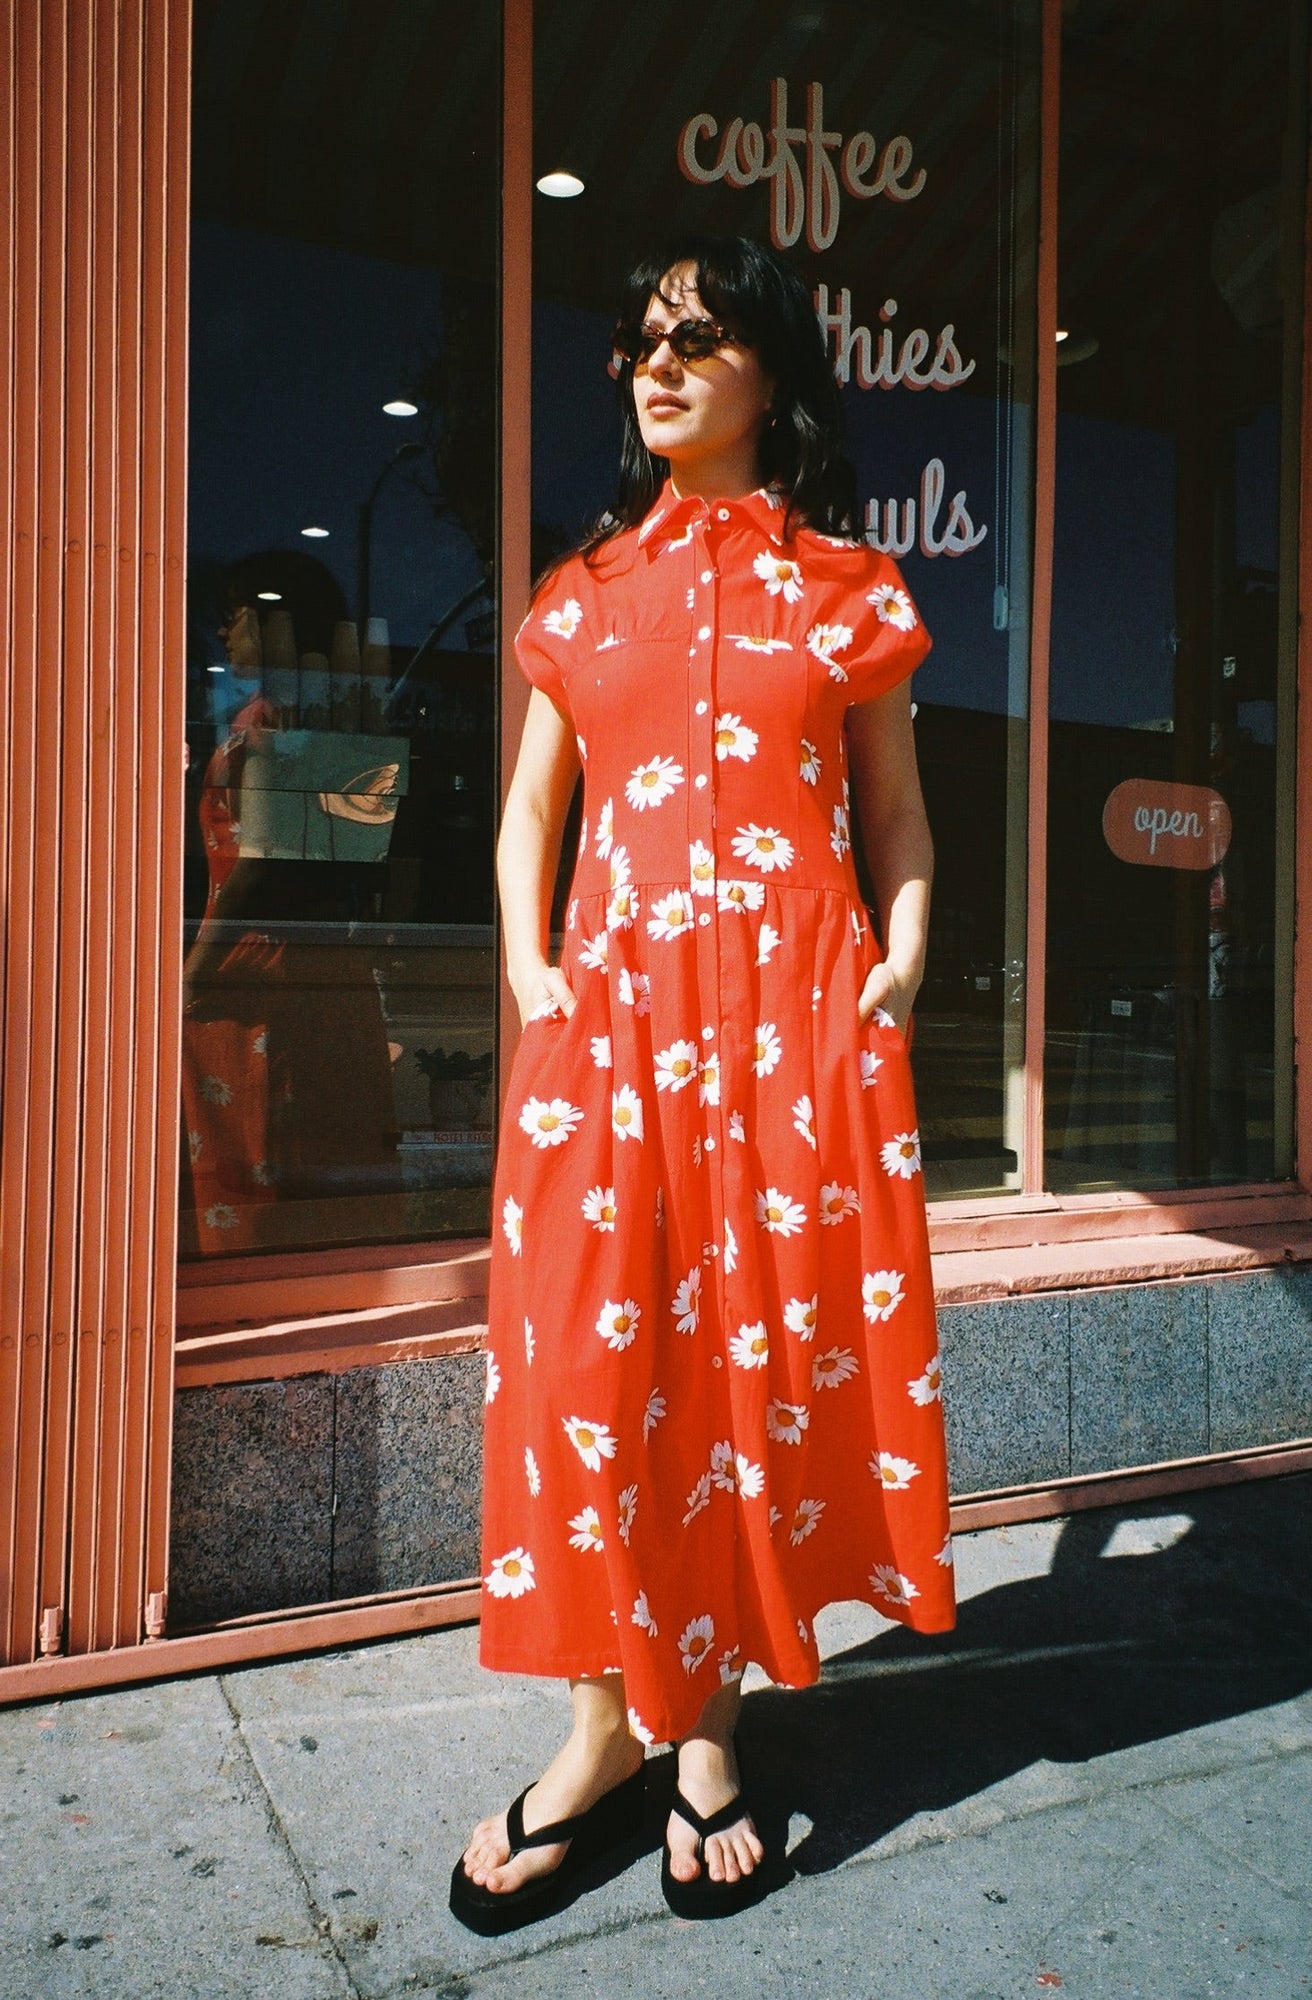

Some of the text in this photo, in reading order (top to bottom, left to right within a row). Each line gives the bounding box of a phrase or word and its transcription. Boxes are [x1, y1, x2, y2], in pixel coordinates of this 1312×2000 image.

[677, 77, 928, 252] coffee
[813, 283, 977, 391] thies
[864, 457, 988, 557] wls
[1134, 805, 1204, 855] open
